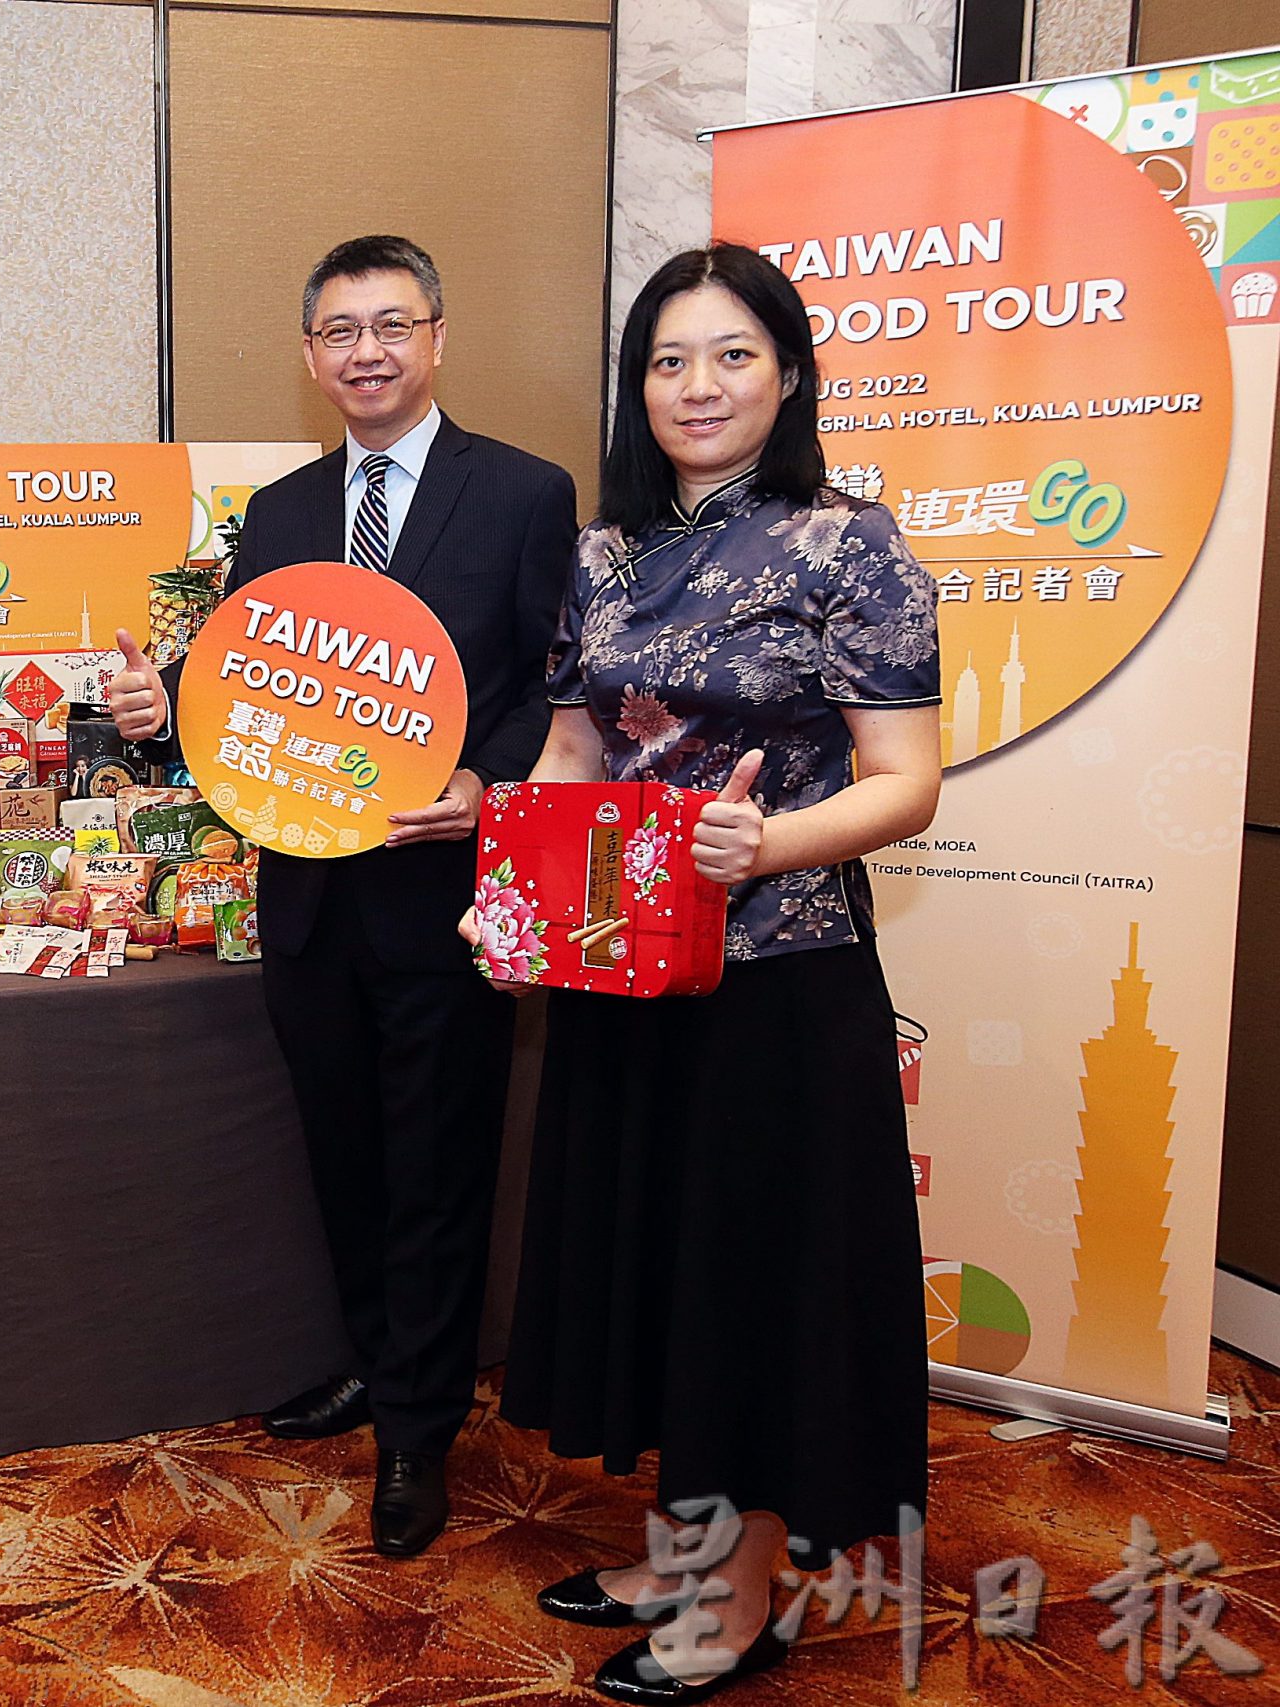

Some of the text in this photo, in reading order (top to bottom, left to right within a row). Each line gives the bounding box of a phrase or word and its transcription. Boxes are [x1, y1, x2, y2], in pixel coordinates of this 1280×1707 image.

[759, 218, 1003, 282] TAIWAN
[809, 278, 1125, 346] OOD TOUR
[858, 373, 927, 398] 2022
[817, 394, 1201, 432] GRI-LA HOTEL, KUALA LUMPUR
[8, 469, 116, 502] TOUR
[21, 513, 74, 529] KUALA
[77, 512, 141, 527] LUMPUR
[936, 565, 1123, 602] 合記者會
[244, 598, 436, 694] TAIWAN
[220, 650, 434, 746] FOOD TOUR
[224, 700, 286, 745] 臺灣
[216, 735, 271, 781] 食品
[271, 769, 367, 815] 聯合記者會
[886, 838, 976, 852] rade, MOEA
[871, 863, 1154, 893] Trade Development Council (TAITRA)
